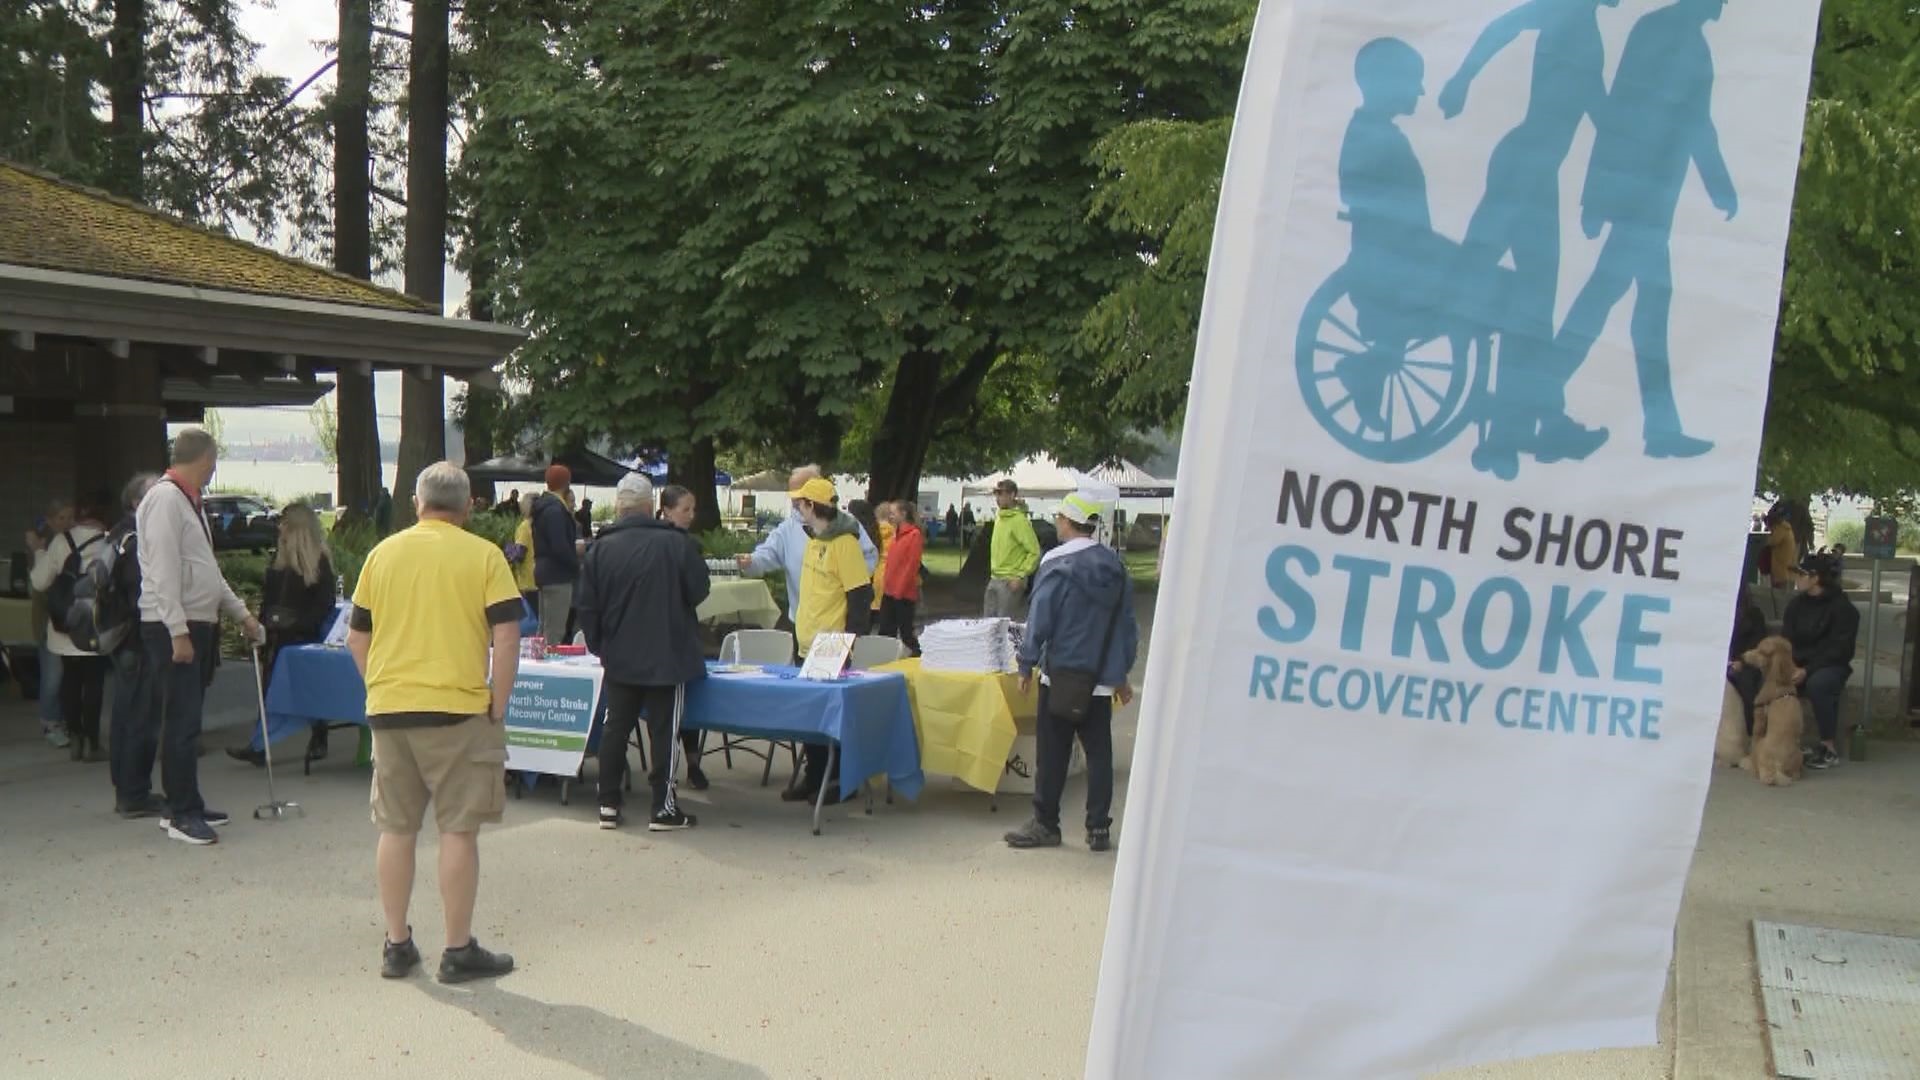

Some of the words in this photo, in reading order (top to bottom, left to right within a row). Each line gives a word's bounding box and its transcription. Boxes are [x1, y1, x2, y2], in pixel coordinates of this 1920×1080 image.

[1276, 469, 1478, 555] NORTH
[1496, 506, 1685, 582] SHORE
[1257, 544, 1671, 684] STROKE
[509, 695, 532, 706] North
[534, 695, 558, 708] Shore
[560, 697, 589, 710] Stroke
[514, 681, 544, 690] UPPORT
[1249, 655, 1484, 725] RECOVERY
[1495, 686, 1664, 741] CENTRE
[509, 706, 546, 722] Recovery
[548, 709, 576, 722] Centre
